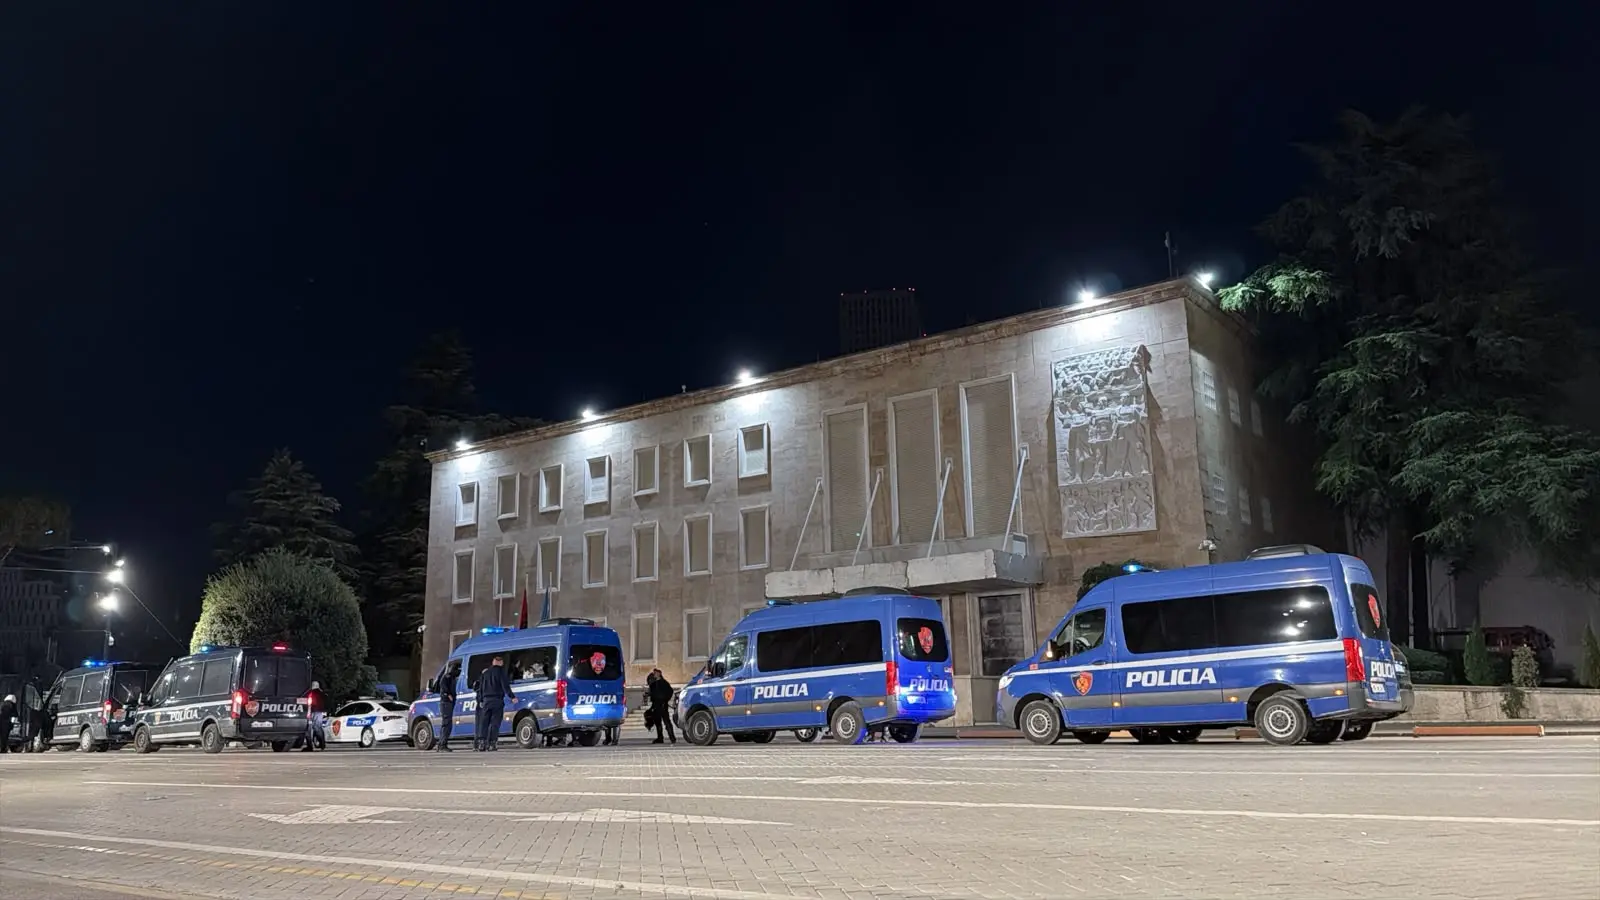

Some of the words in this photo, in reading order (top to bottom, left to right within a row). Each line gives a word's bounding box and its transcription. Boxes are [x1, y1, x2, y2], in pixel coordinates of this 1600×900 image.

[1126, 667, 1216, 687] POLICIA
[754, 682, 808, 699] POLICIA
[910, 679, 948, 691] POLICIA
[577, 695, 616, 704] POLICIA
[261, 703, 304, 713] POLICIA
[57, 716, 79, 726] POLICIA
[170, 709, 199, 721] POLICIA
